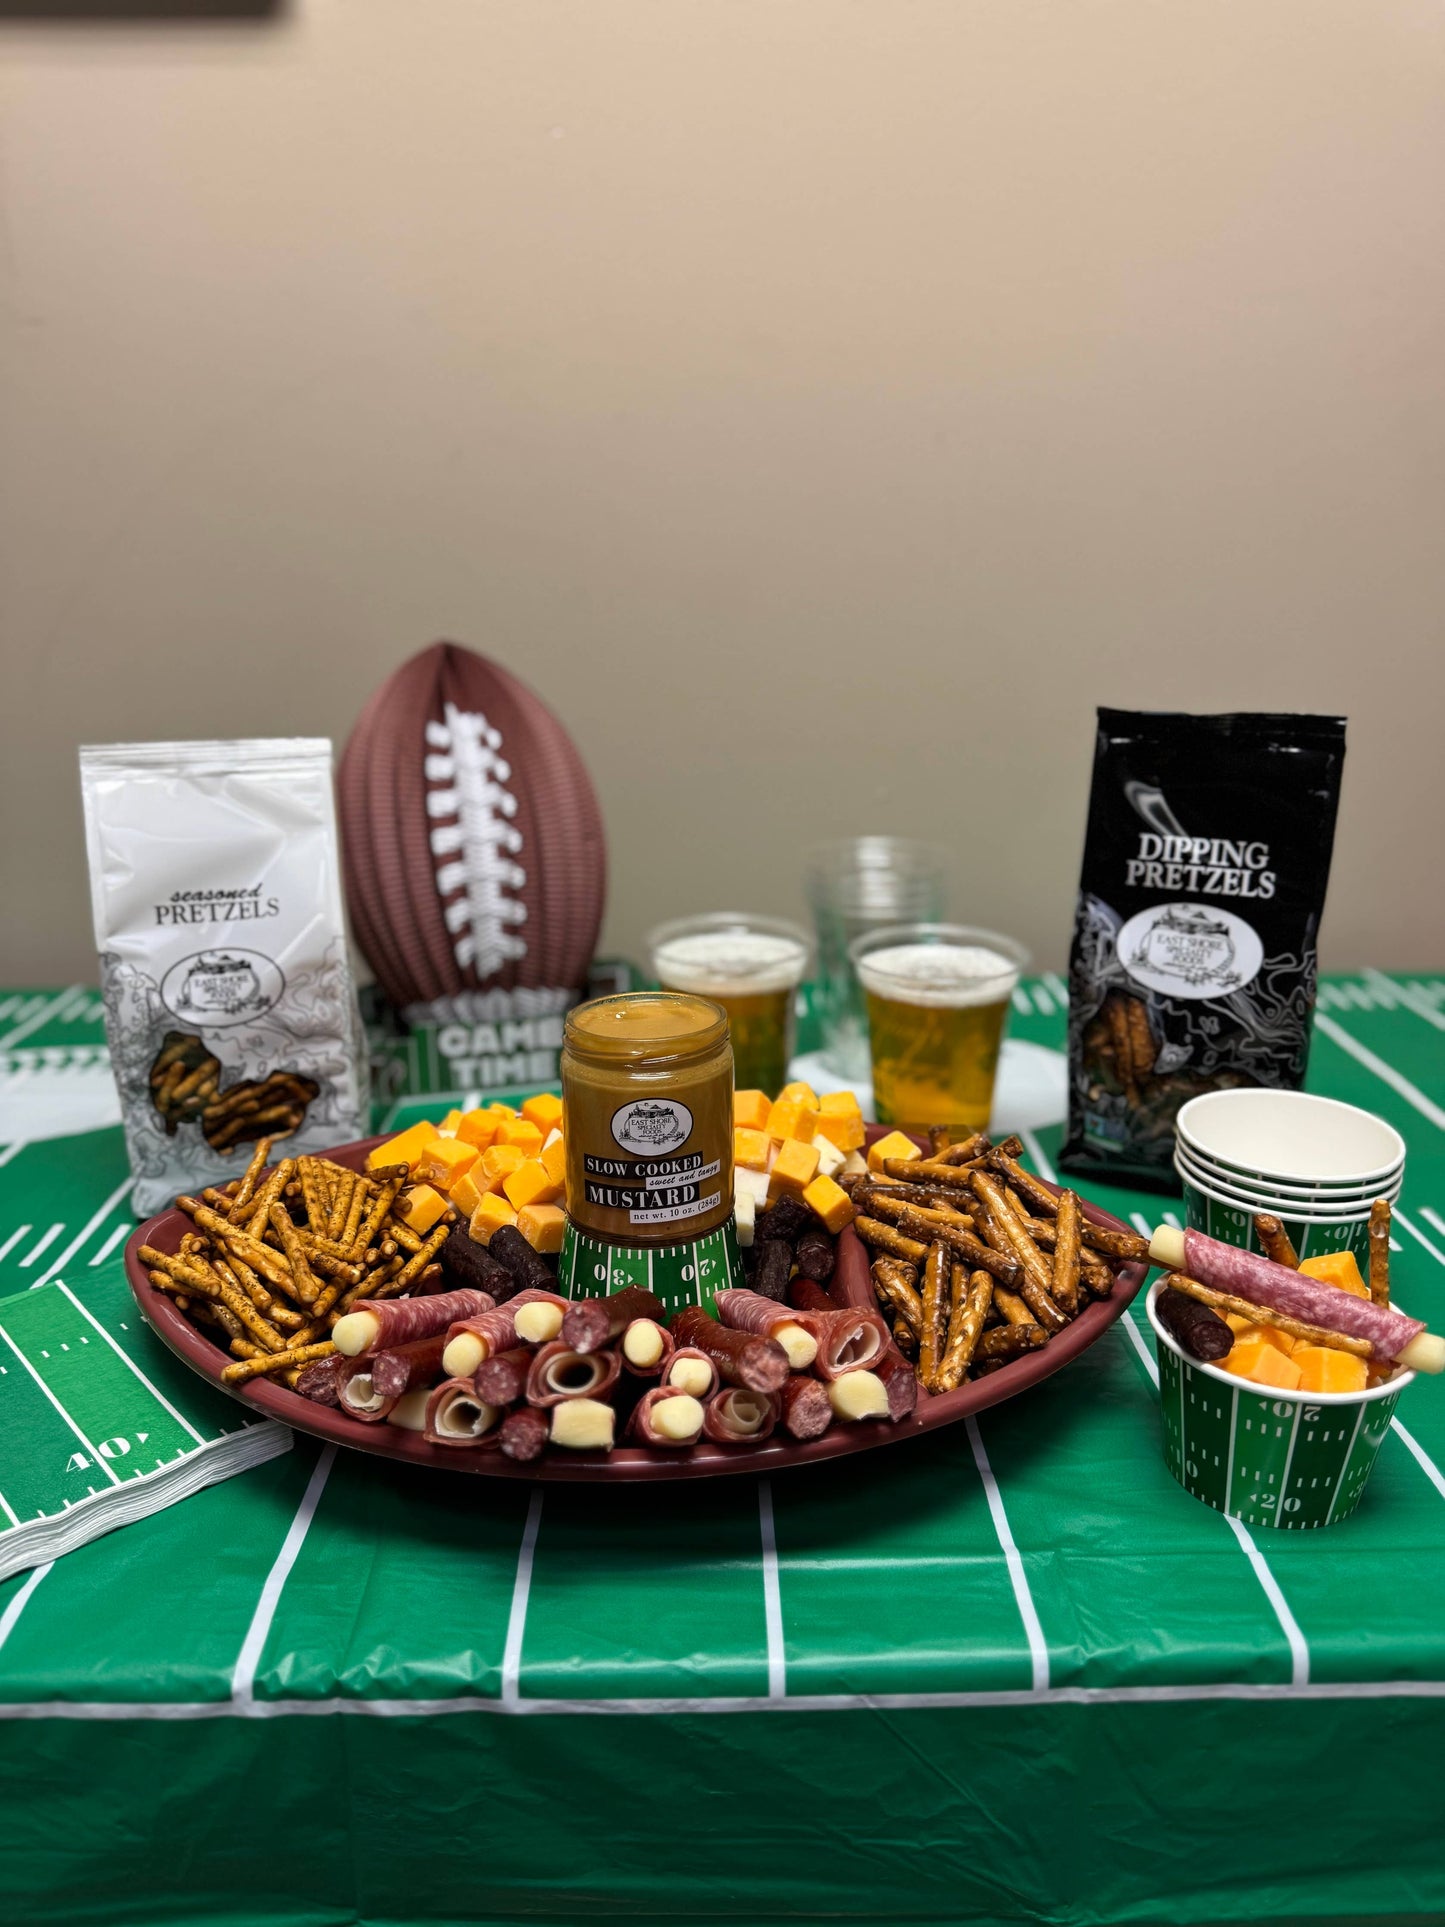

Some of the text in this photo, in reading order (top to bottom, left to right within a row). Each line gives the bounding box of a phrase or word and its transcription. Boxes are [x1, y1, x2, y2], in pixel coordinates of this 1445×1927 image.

[1137, 833, 1269, 869] DIPPING
[1125, 859, 1276, 899] PRETZELS
[170, 882, 263, 902] seasoned
[154, 898, 279, 925] PRETZELS
[449, 1051, 557, 1088] TIME
[650, 1117, 672, 1125] SHORE
[587, 1155, 702, 1176] SLOW COOKED
[649, 1164, 718, 1186] sweet and tangy
[589, 1185, 696, 1208] MUSTARD
[670, 1208, 680, 1217] 10
[697, 1194, 719, 1211] (284g)
[66, 1437, 131, 1473] 40
[1260, 1493, 1302, 1513] 20
